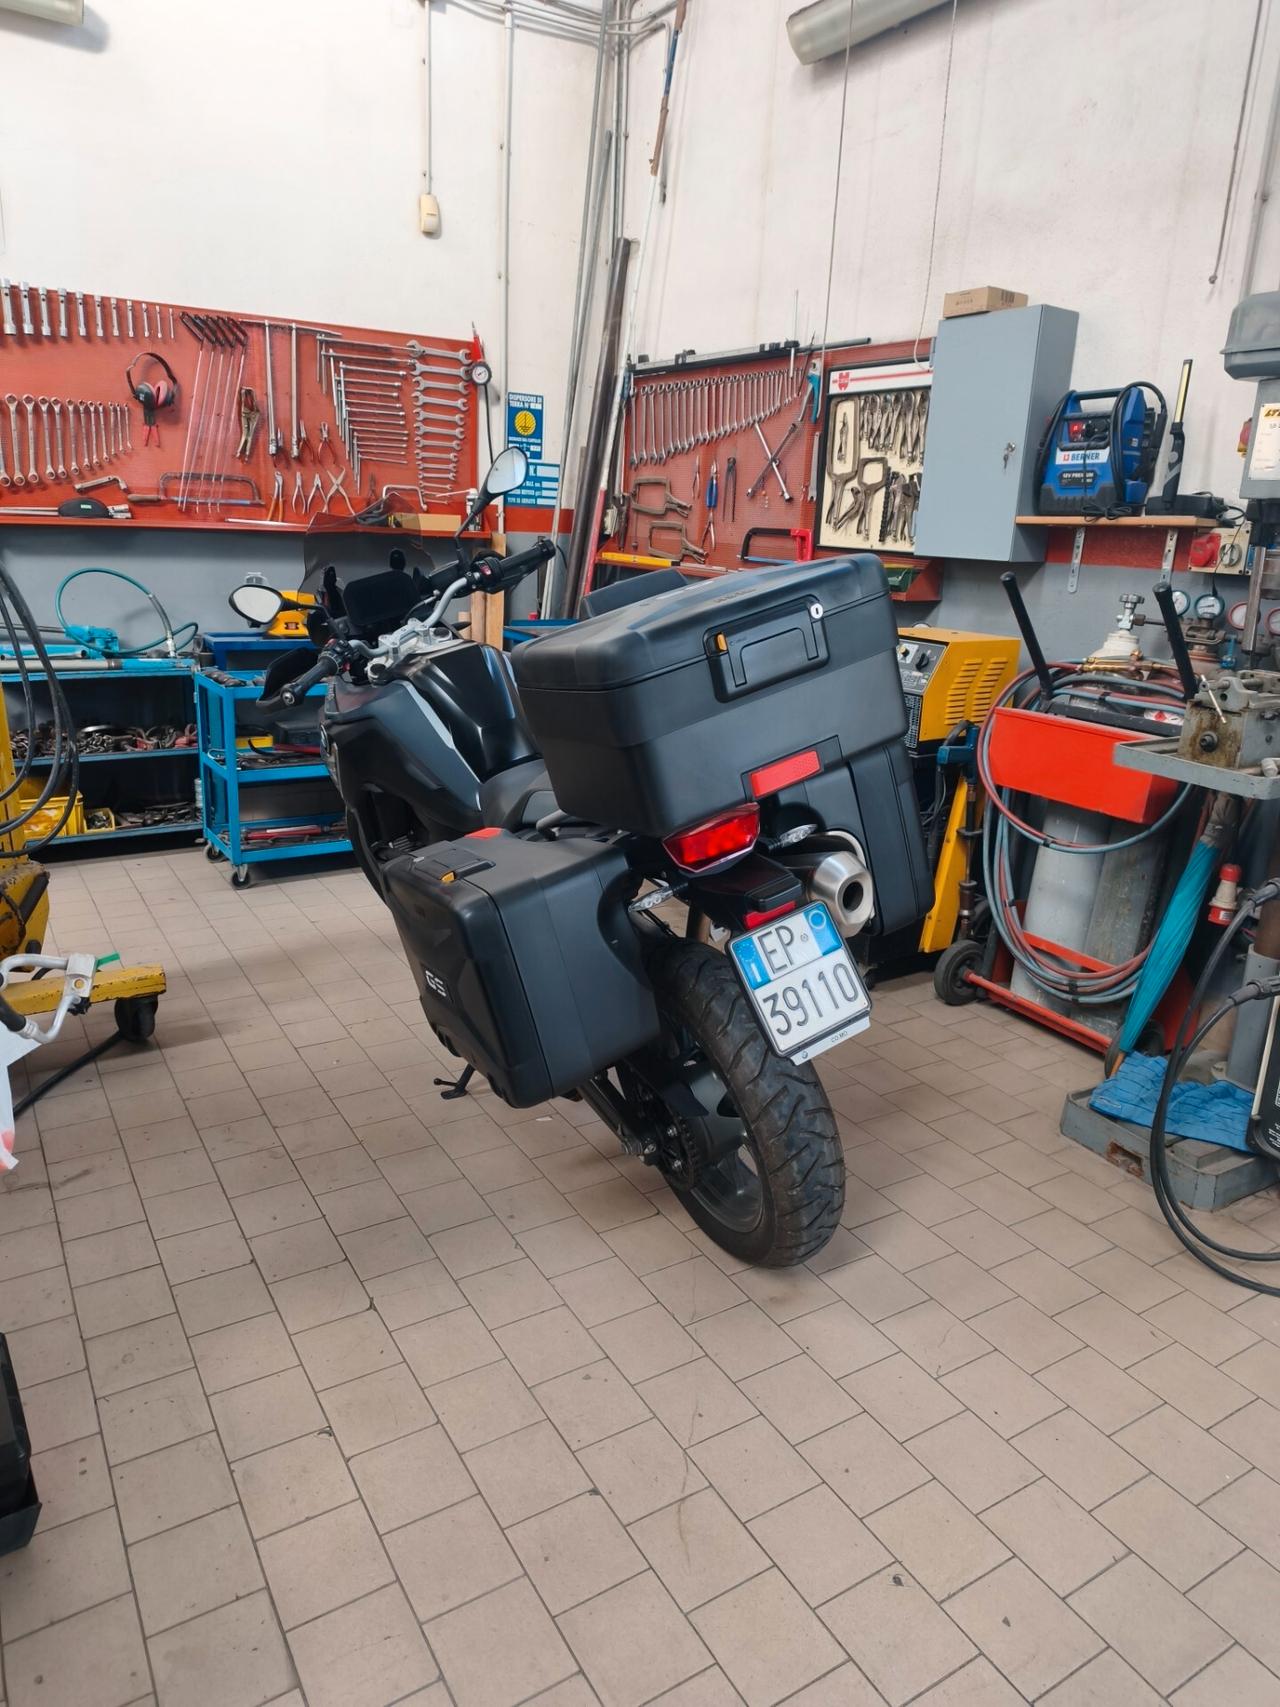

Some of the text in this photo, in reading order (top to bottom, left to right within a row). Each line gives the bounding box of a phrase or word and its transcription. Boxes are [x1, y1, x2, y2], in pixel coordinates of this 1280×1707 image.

[1071, 452, 1100, 461] BERNER
[757, 925, 794, 974] EP
[425, 970, 447, 997] GS
[762, 963, 859, 1035] 39110
